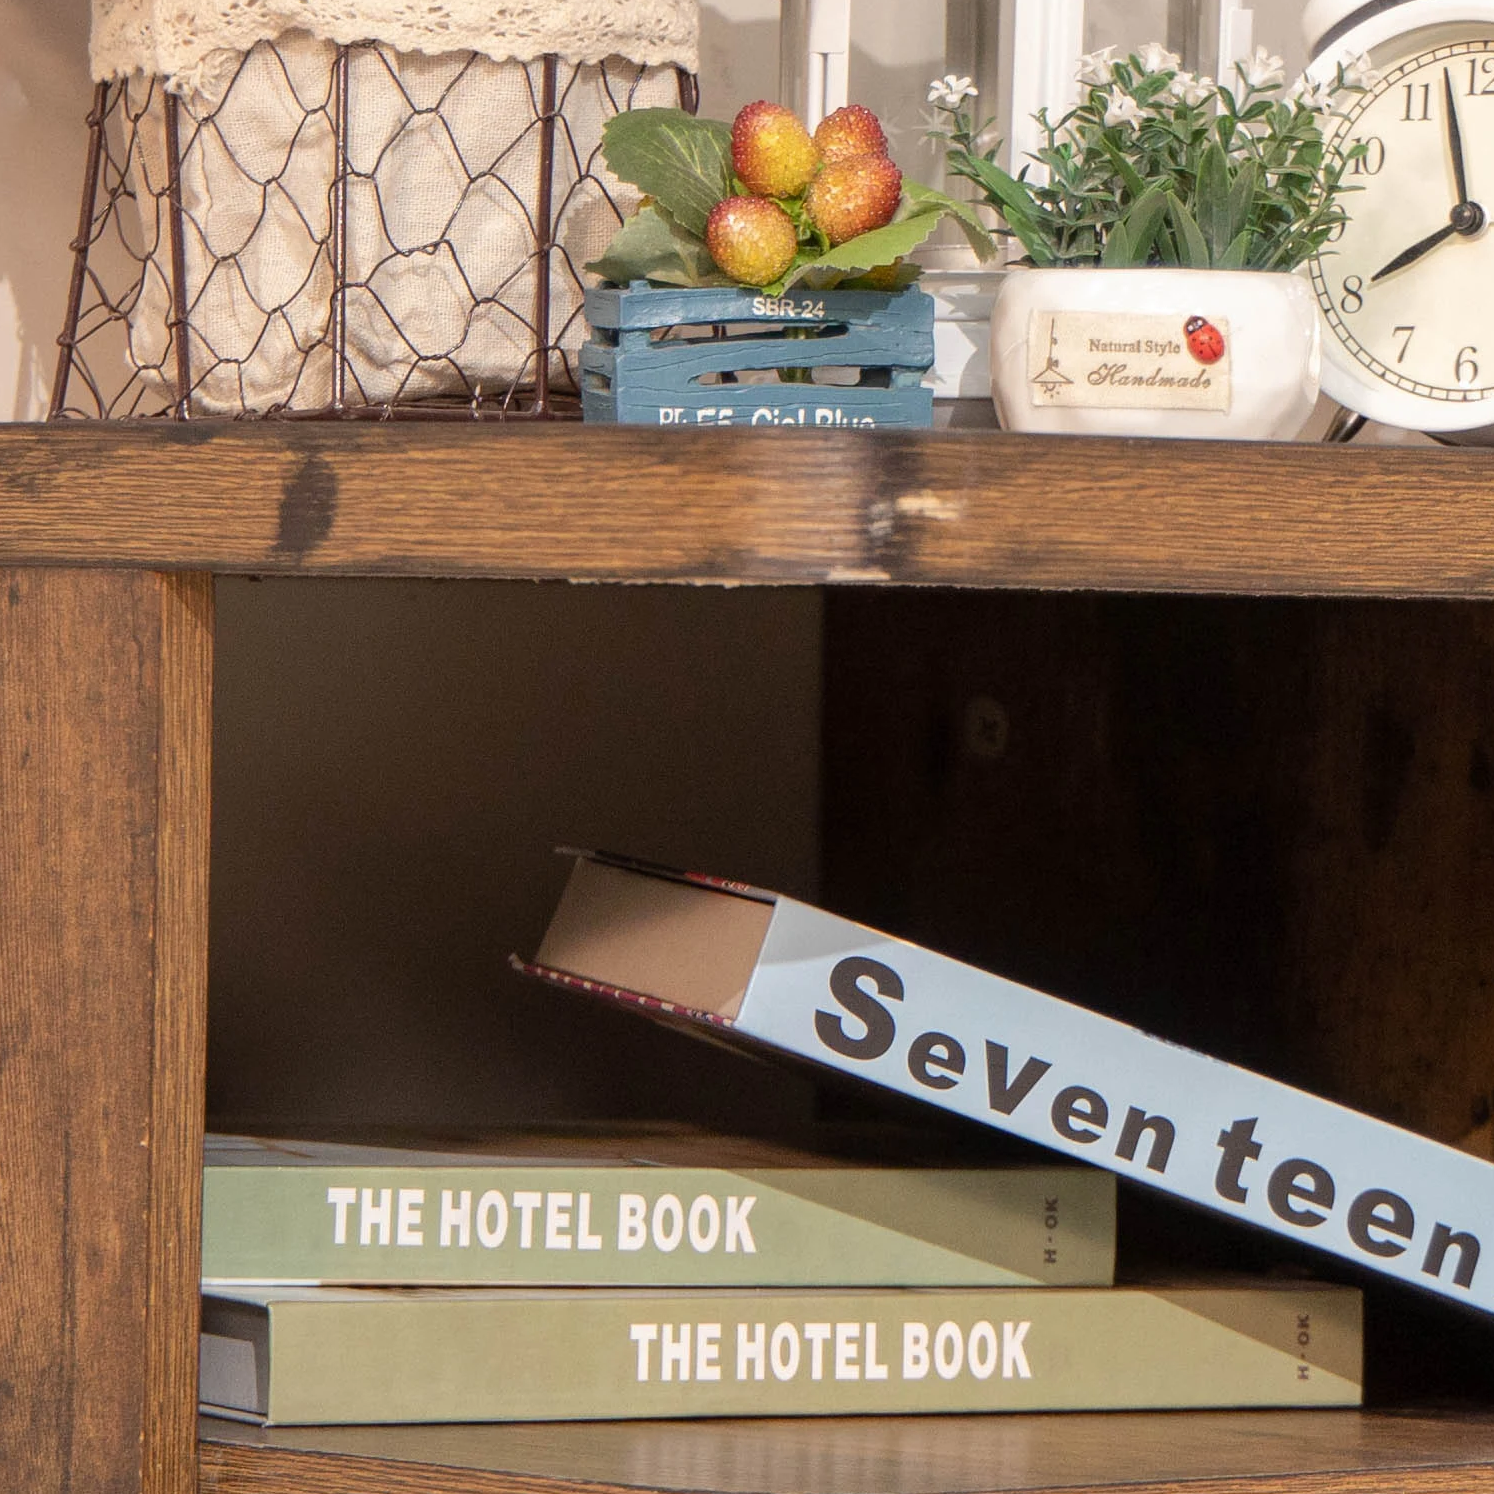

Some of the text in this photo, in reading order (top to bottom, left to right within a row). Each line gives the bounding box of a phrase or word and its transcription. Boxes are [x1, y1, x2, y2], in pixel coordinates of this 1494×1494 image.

[1399, 83, 1433, 121] 11
[1349, 136, 1385, 175] 10
[752, 297, 825, 318] SBR-24
[1340, 275, 1364, 314] 8
[1089, 338, 1141, 353] Natural
[1391, 325, 1416, 364] 7
[1087, 363, 1212, 389] Handmade
[1454, 346, 1479, 384] 6
[814, 956, 1176, 1175] Seven
[1215, 1117, 1482, 1290] teen
[327, 1187, 757, 1253] THE HOTEL BOOK
[630, 1321, 1032, 1381] THE HOTEL BOOK
